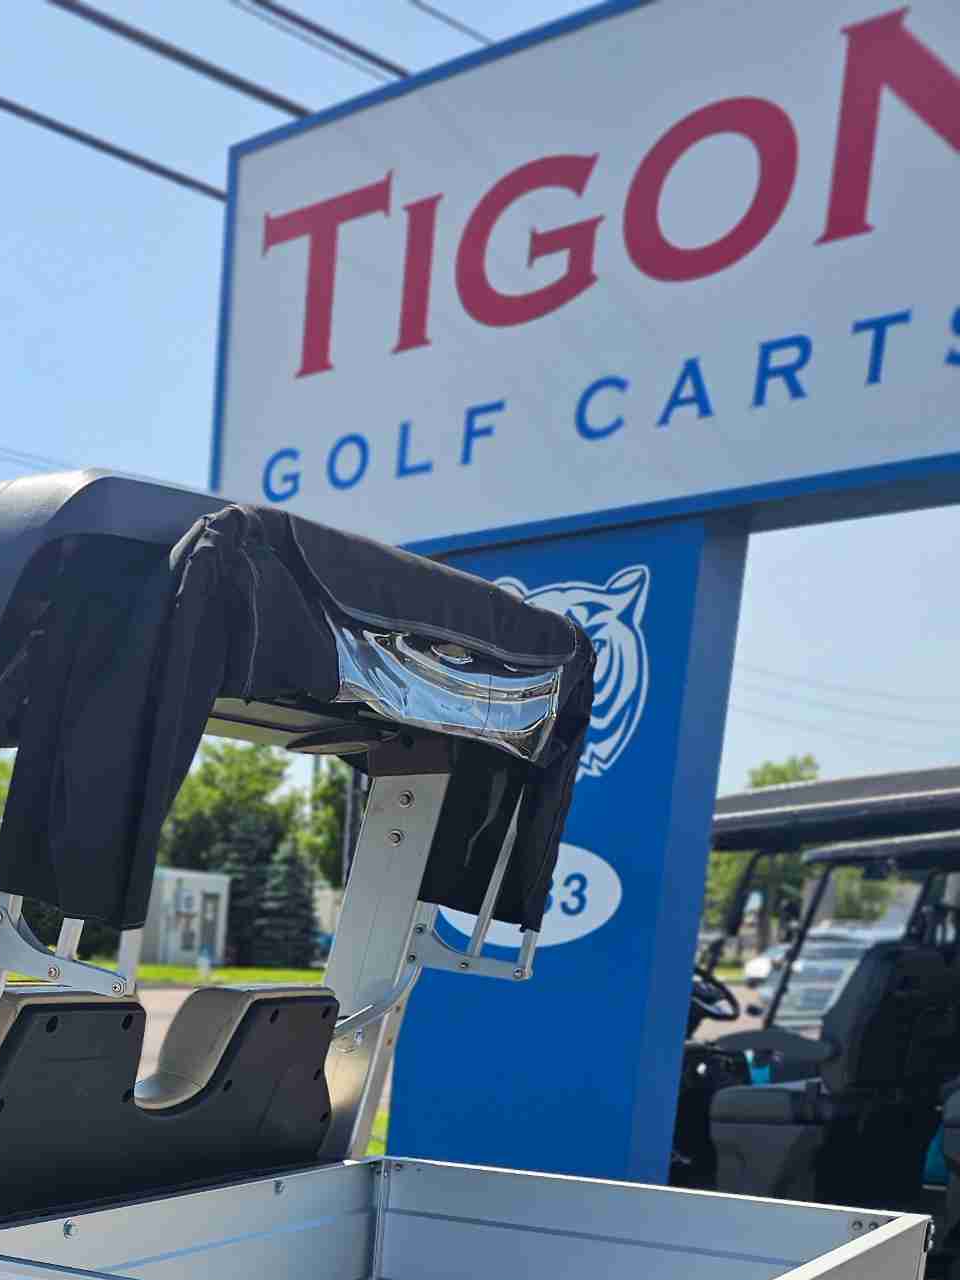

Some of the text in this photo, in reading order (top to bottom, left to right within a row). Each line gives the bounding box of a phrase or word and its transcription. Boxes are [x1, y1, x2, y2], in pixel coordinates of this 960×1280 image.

[261, 6, 960, 379] TIGON
[261, 307, 960, 503] GOLF CART
